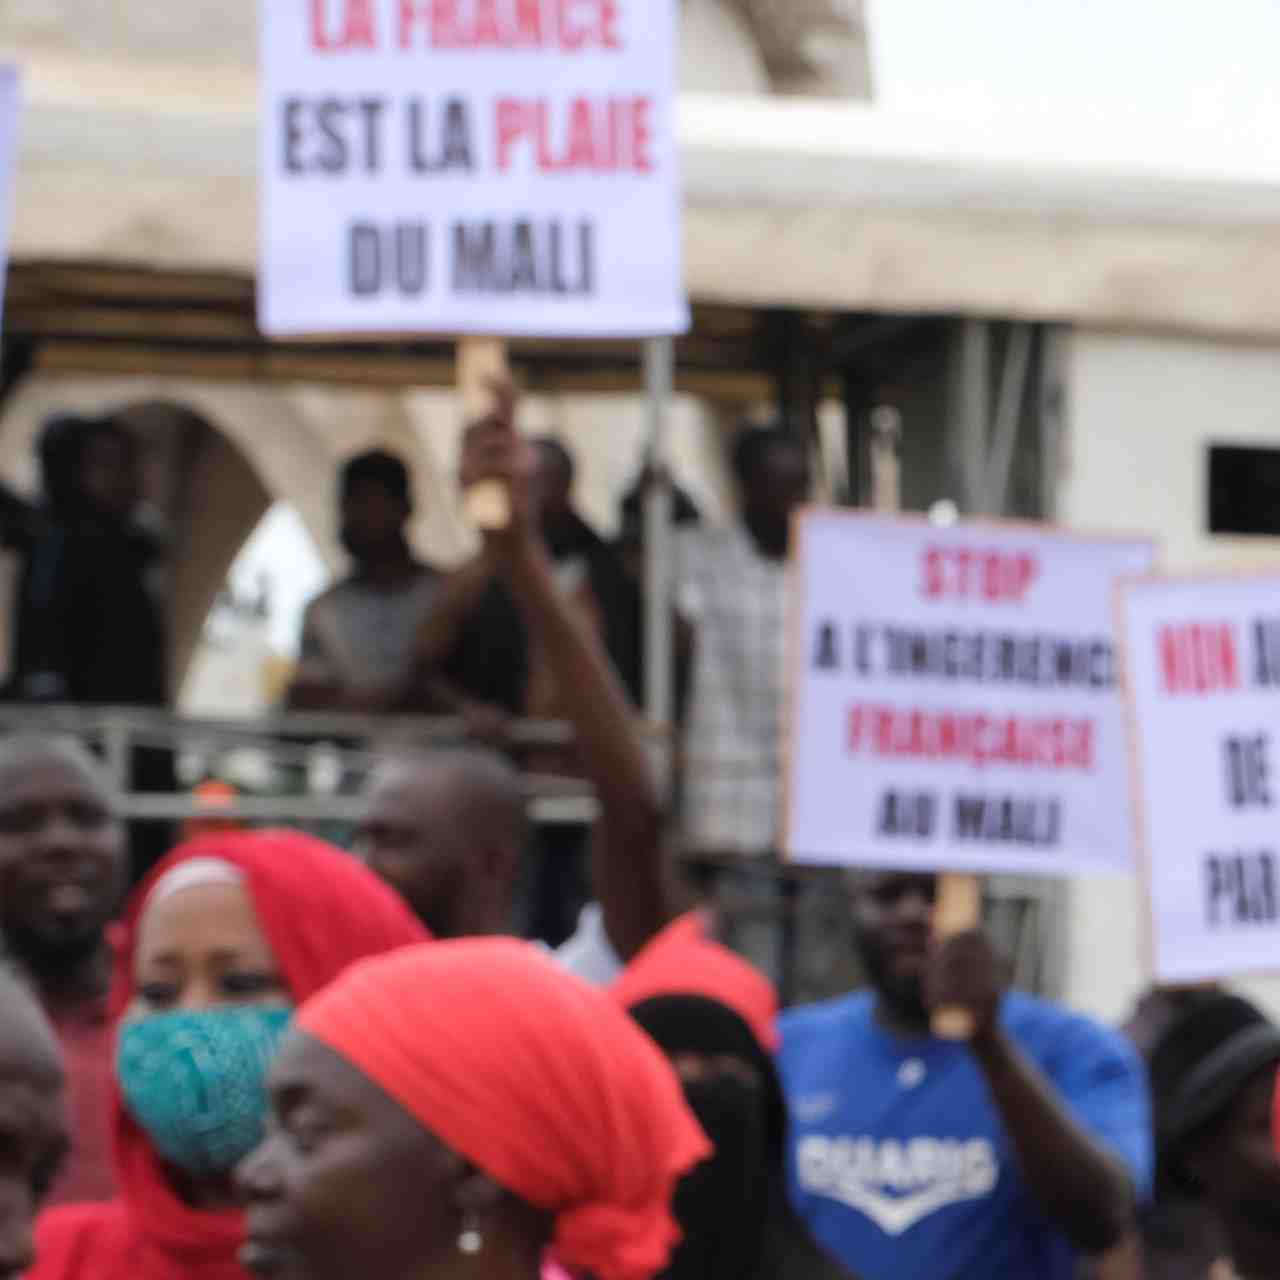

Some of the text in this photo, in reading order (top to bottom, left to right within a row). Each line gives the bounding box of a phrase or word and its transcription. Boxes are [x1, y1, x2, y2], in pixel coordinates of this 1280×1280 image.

[310, 0, 624, 52] LA FRANCE
[283, 95, 655, 174] EST LA PLAIE
[347, 219, 597, 296] DU MALI
[921, 544, 1037, 601] STOP
[813, 620, 1114, 692] A L'INGERENC
[1158, 623, 1238, 693] NON
[845, 703, 1095, 771] FRANÇAISE
[1223, 734, 1271, 808] DE
[877, 789, 1060, 846] AU MALI
[1205, 851, 1277, 928] PAR
